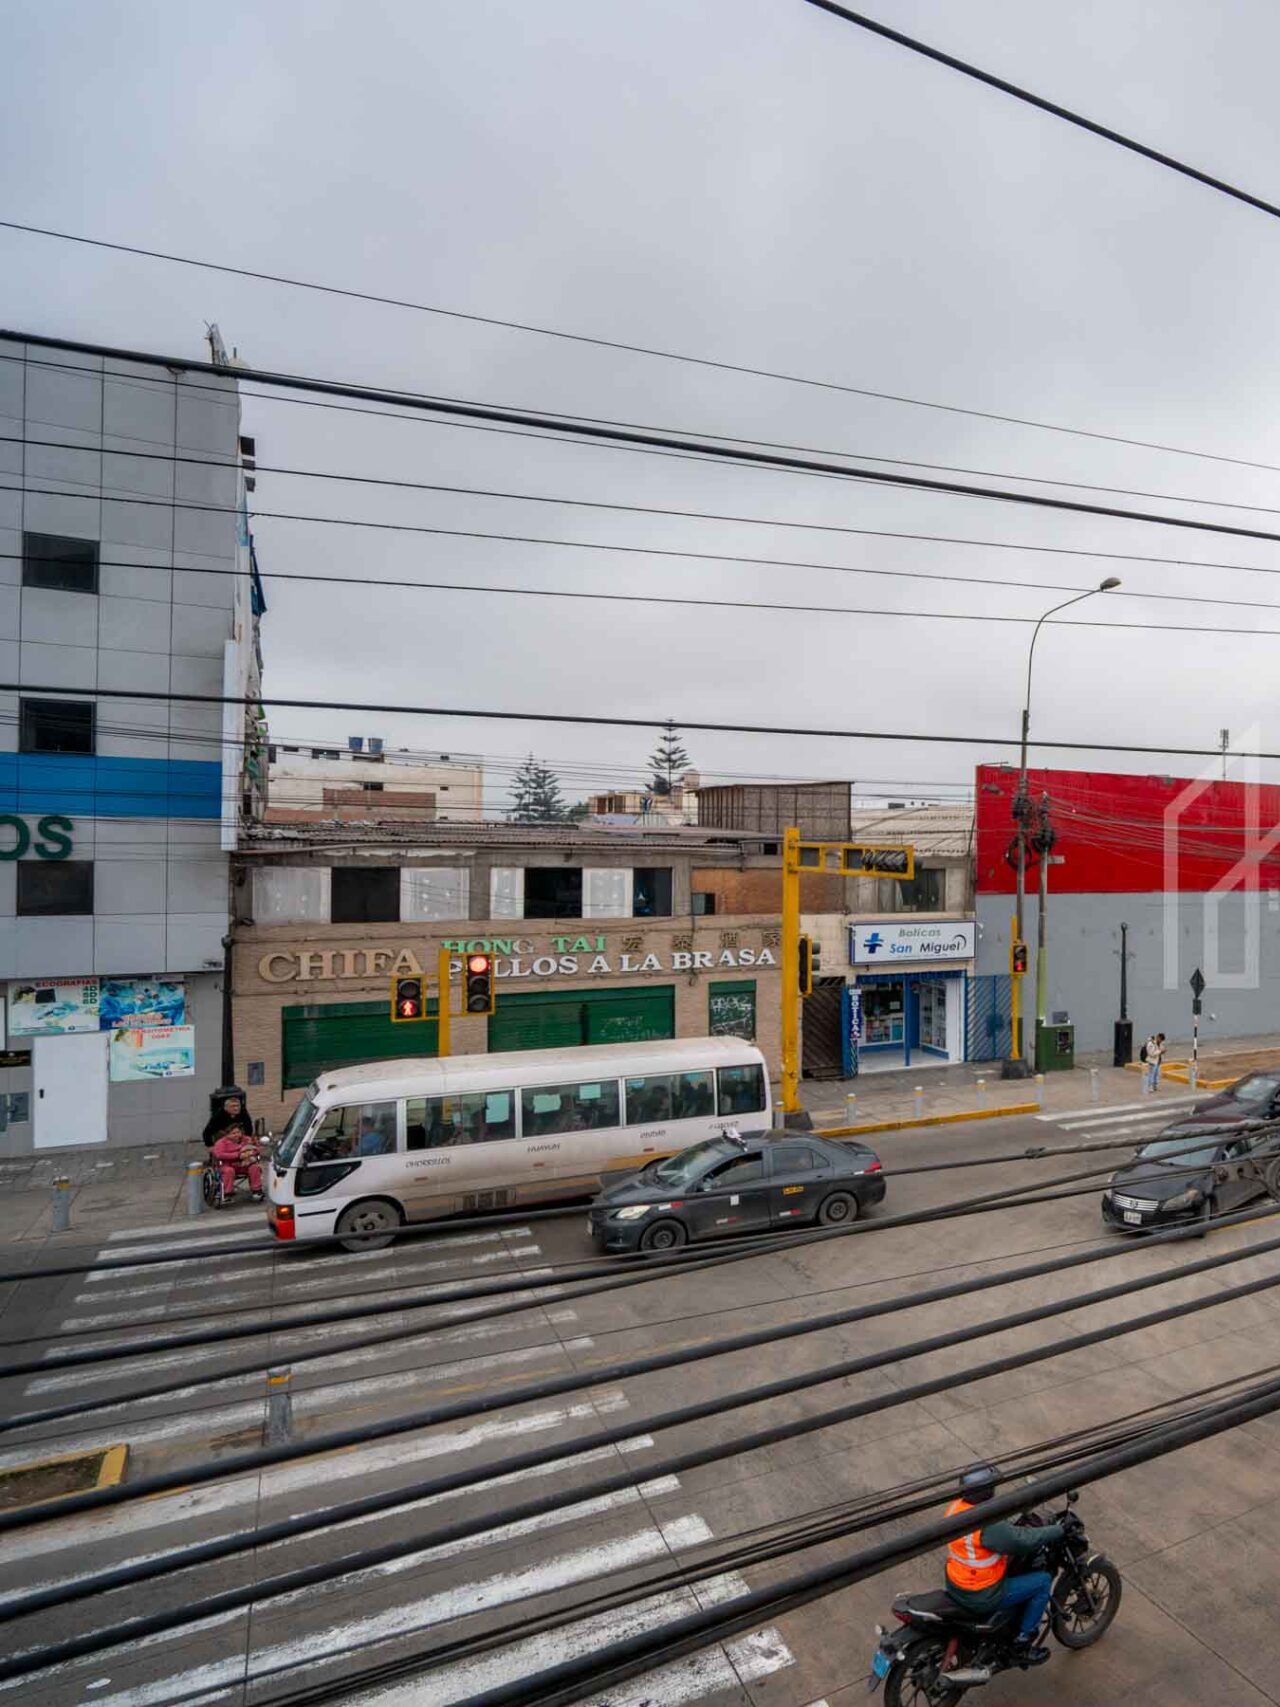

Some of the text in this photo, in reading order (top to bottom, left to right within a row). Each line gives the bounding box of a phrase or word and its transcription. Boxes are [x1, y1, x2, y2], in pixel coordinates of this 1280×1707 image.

[898, 928, 942, 938] Boticas
[440, 935, 607, 956] HONG TAI
[889, 941, 961, 954] San Miguel
[257, 947, 424, 984] CHIFA
[448, 948, 777, 979] PLLOS A LA BRASA
[36, 978, 98, 988] ECOGRAFIAS
